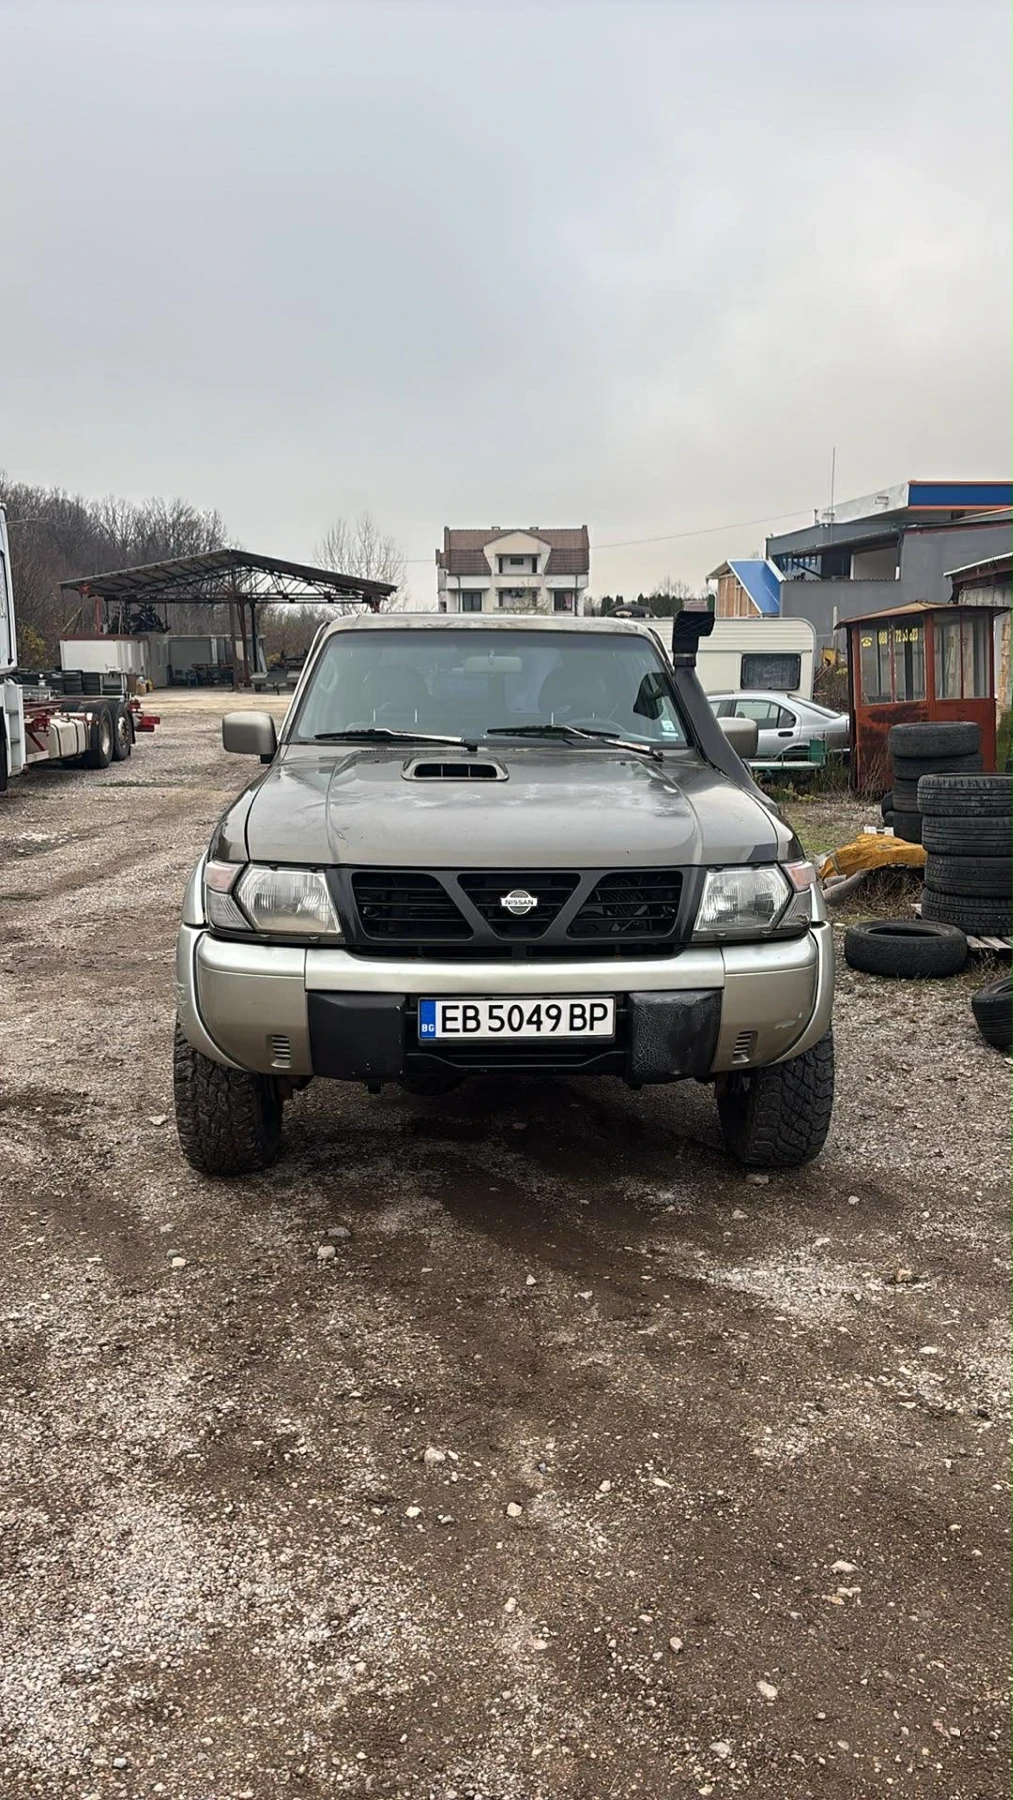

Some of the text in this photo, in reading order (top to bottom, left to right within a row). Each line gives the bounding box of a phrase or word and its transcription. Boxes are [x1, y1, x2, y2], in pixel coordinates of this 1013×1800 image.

[441, 1003, 608, 1033] EB 5049 BP
[421, 1024, 435, 1032] BG
